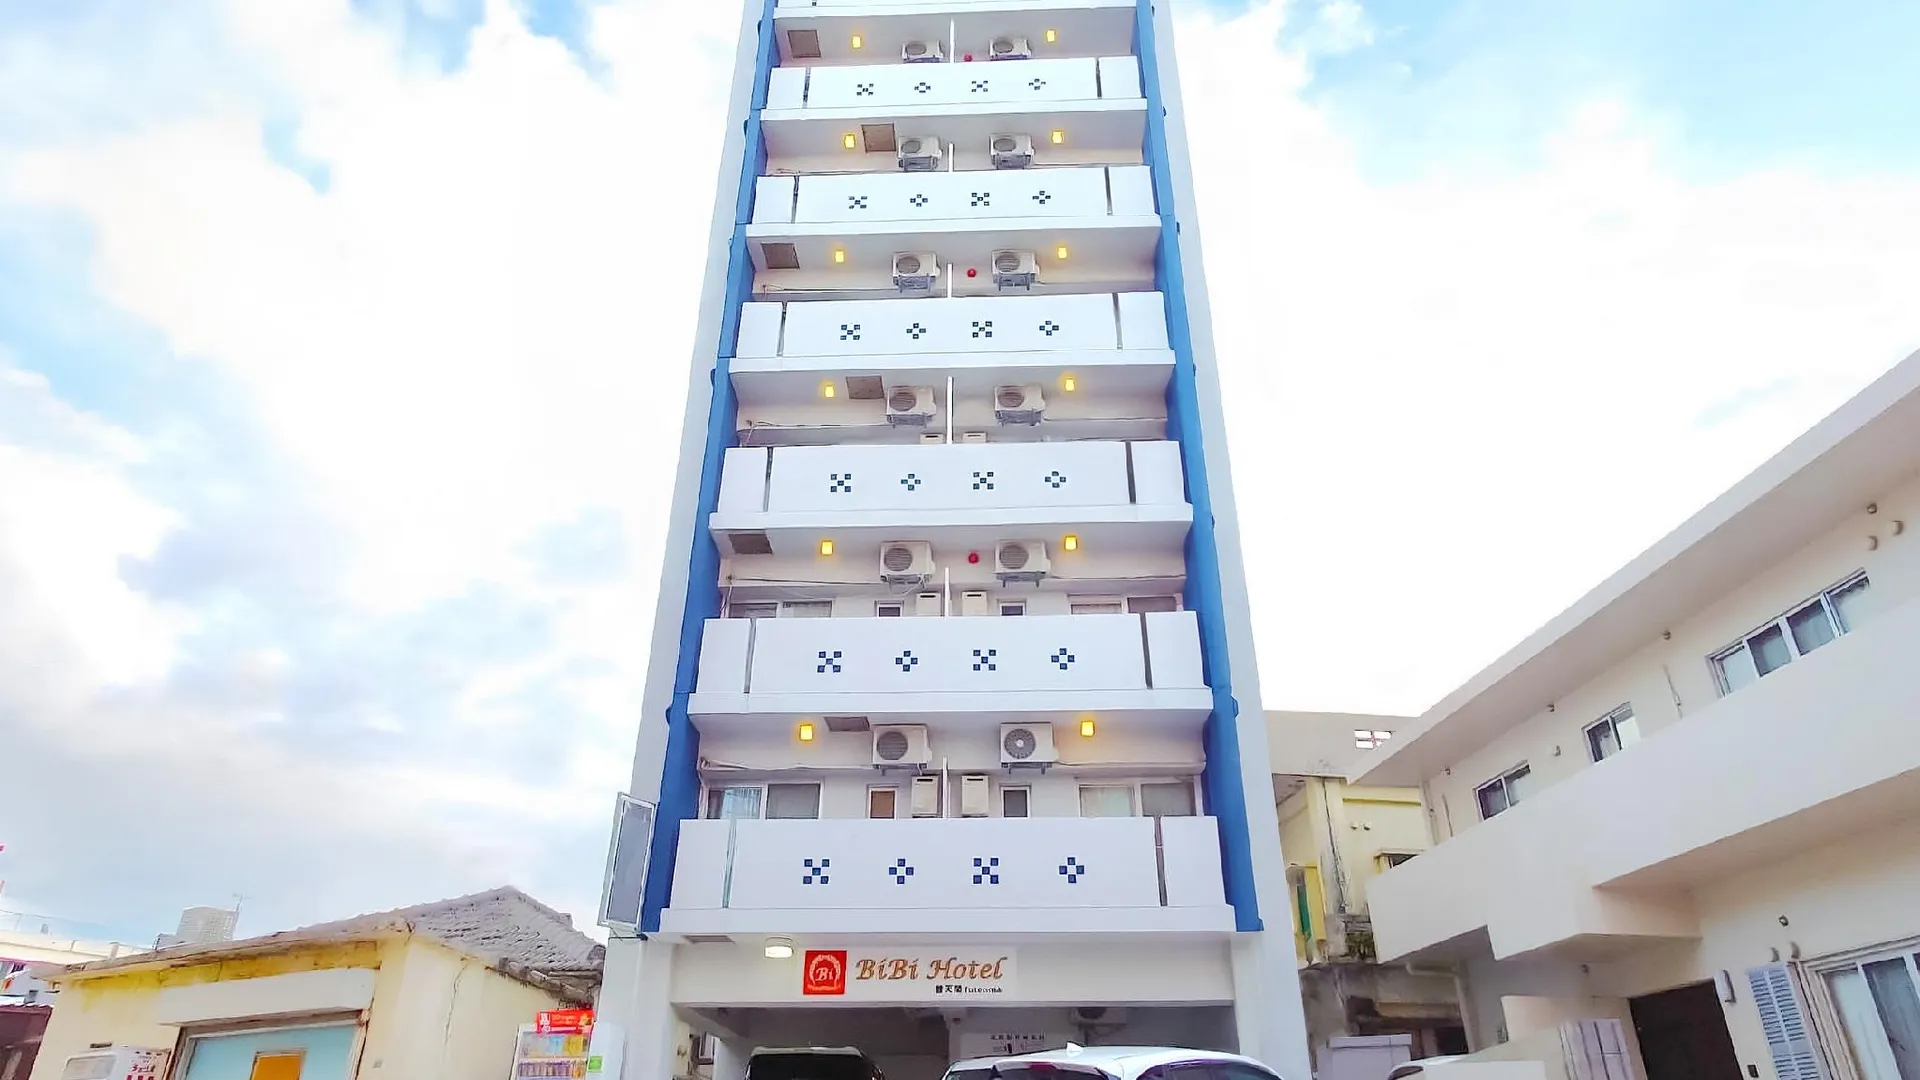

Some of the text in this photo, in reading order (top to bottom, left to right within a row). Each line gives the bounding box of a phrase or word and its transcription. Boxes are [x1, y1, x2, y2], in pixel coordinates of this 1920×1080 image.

[815, 967, 834, 981] Bi
[855, 956, 1008, 980] BiBi Hotel
